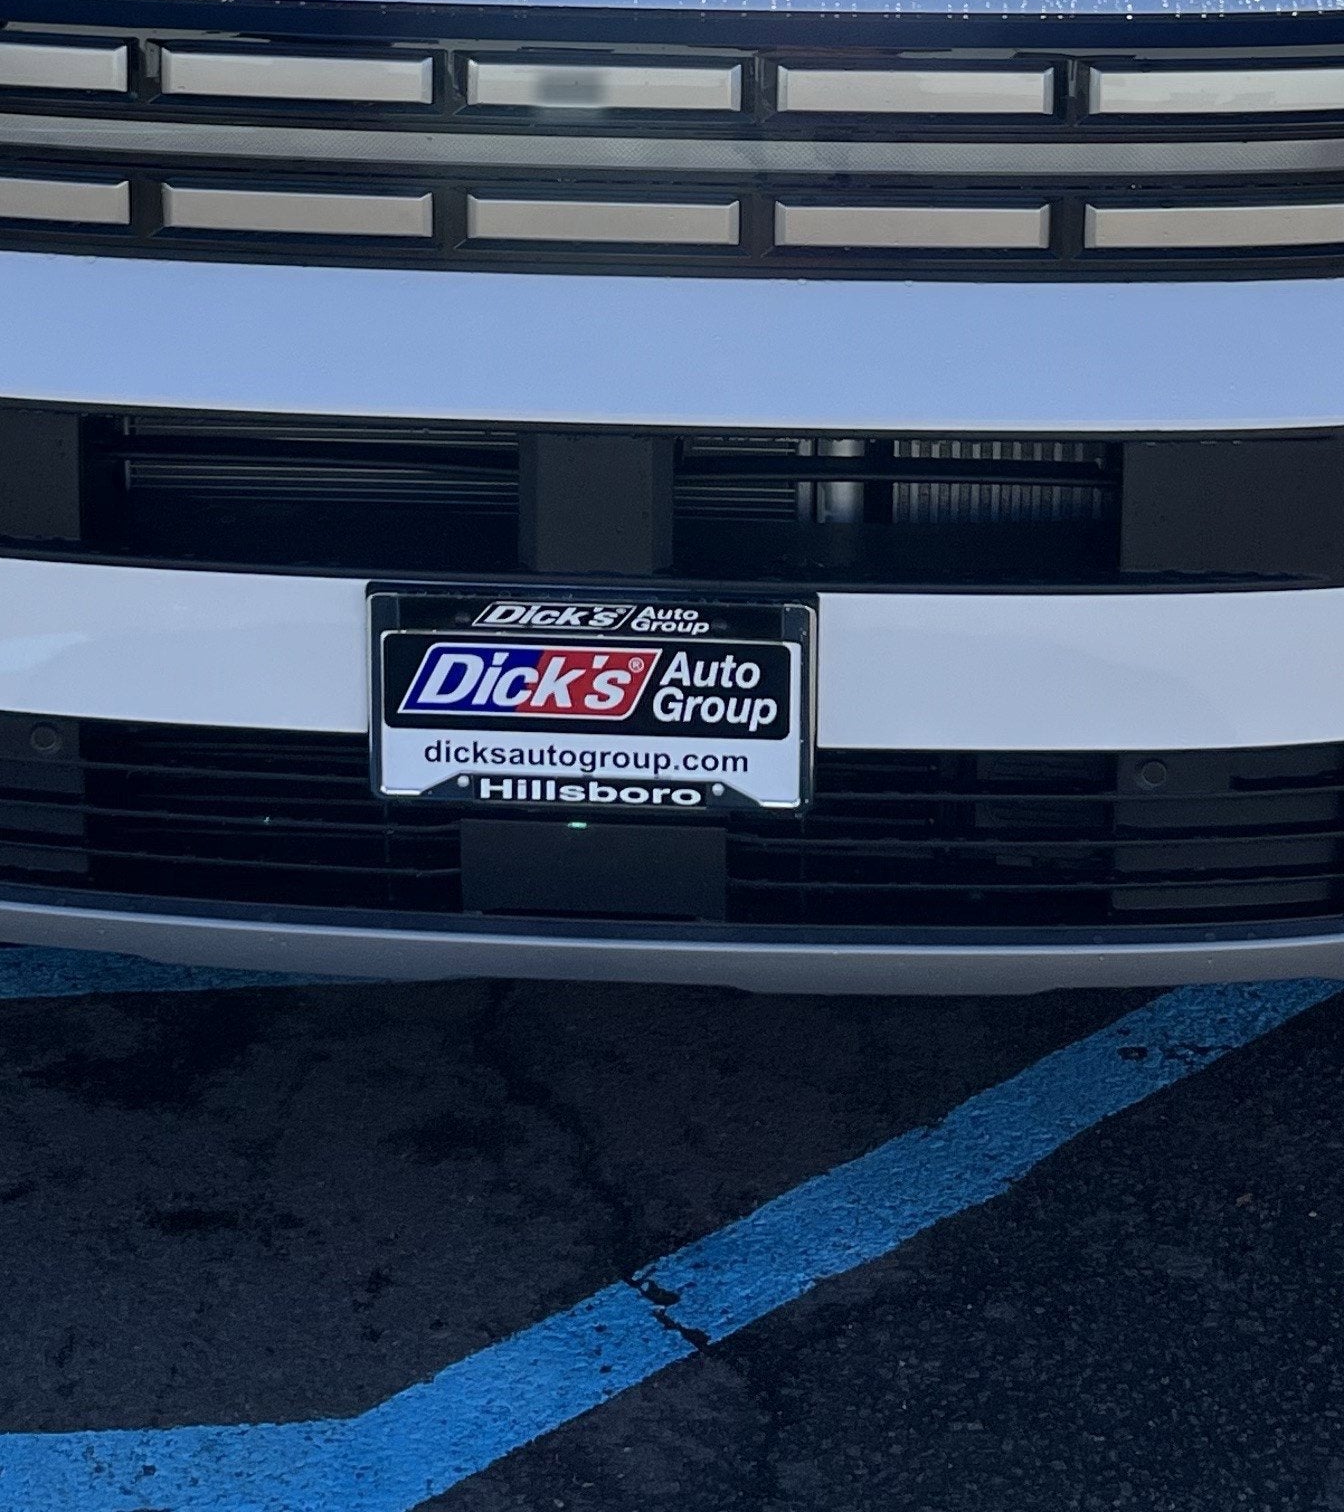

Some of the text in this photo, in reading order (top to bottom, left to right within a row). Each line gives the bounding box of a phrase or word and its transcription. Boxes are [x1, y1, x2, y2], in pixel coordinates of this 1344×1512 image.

[484, 605, 699, 628] Dick's Auto
[630, 619, 710, 636] Group
[416, 651, 760, 711] Dick's Auto
[652, 687, 778, 732] Group
[424, 740, 749, 774] dicksautogroup.com
[479, 778, 702, 805] Hillsboro
